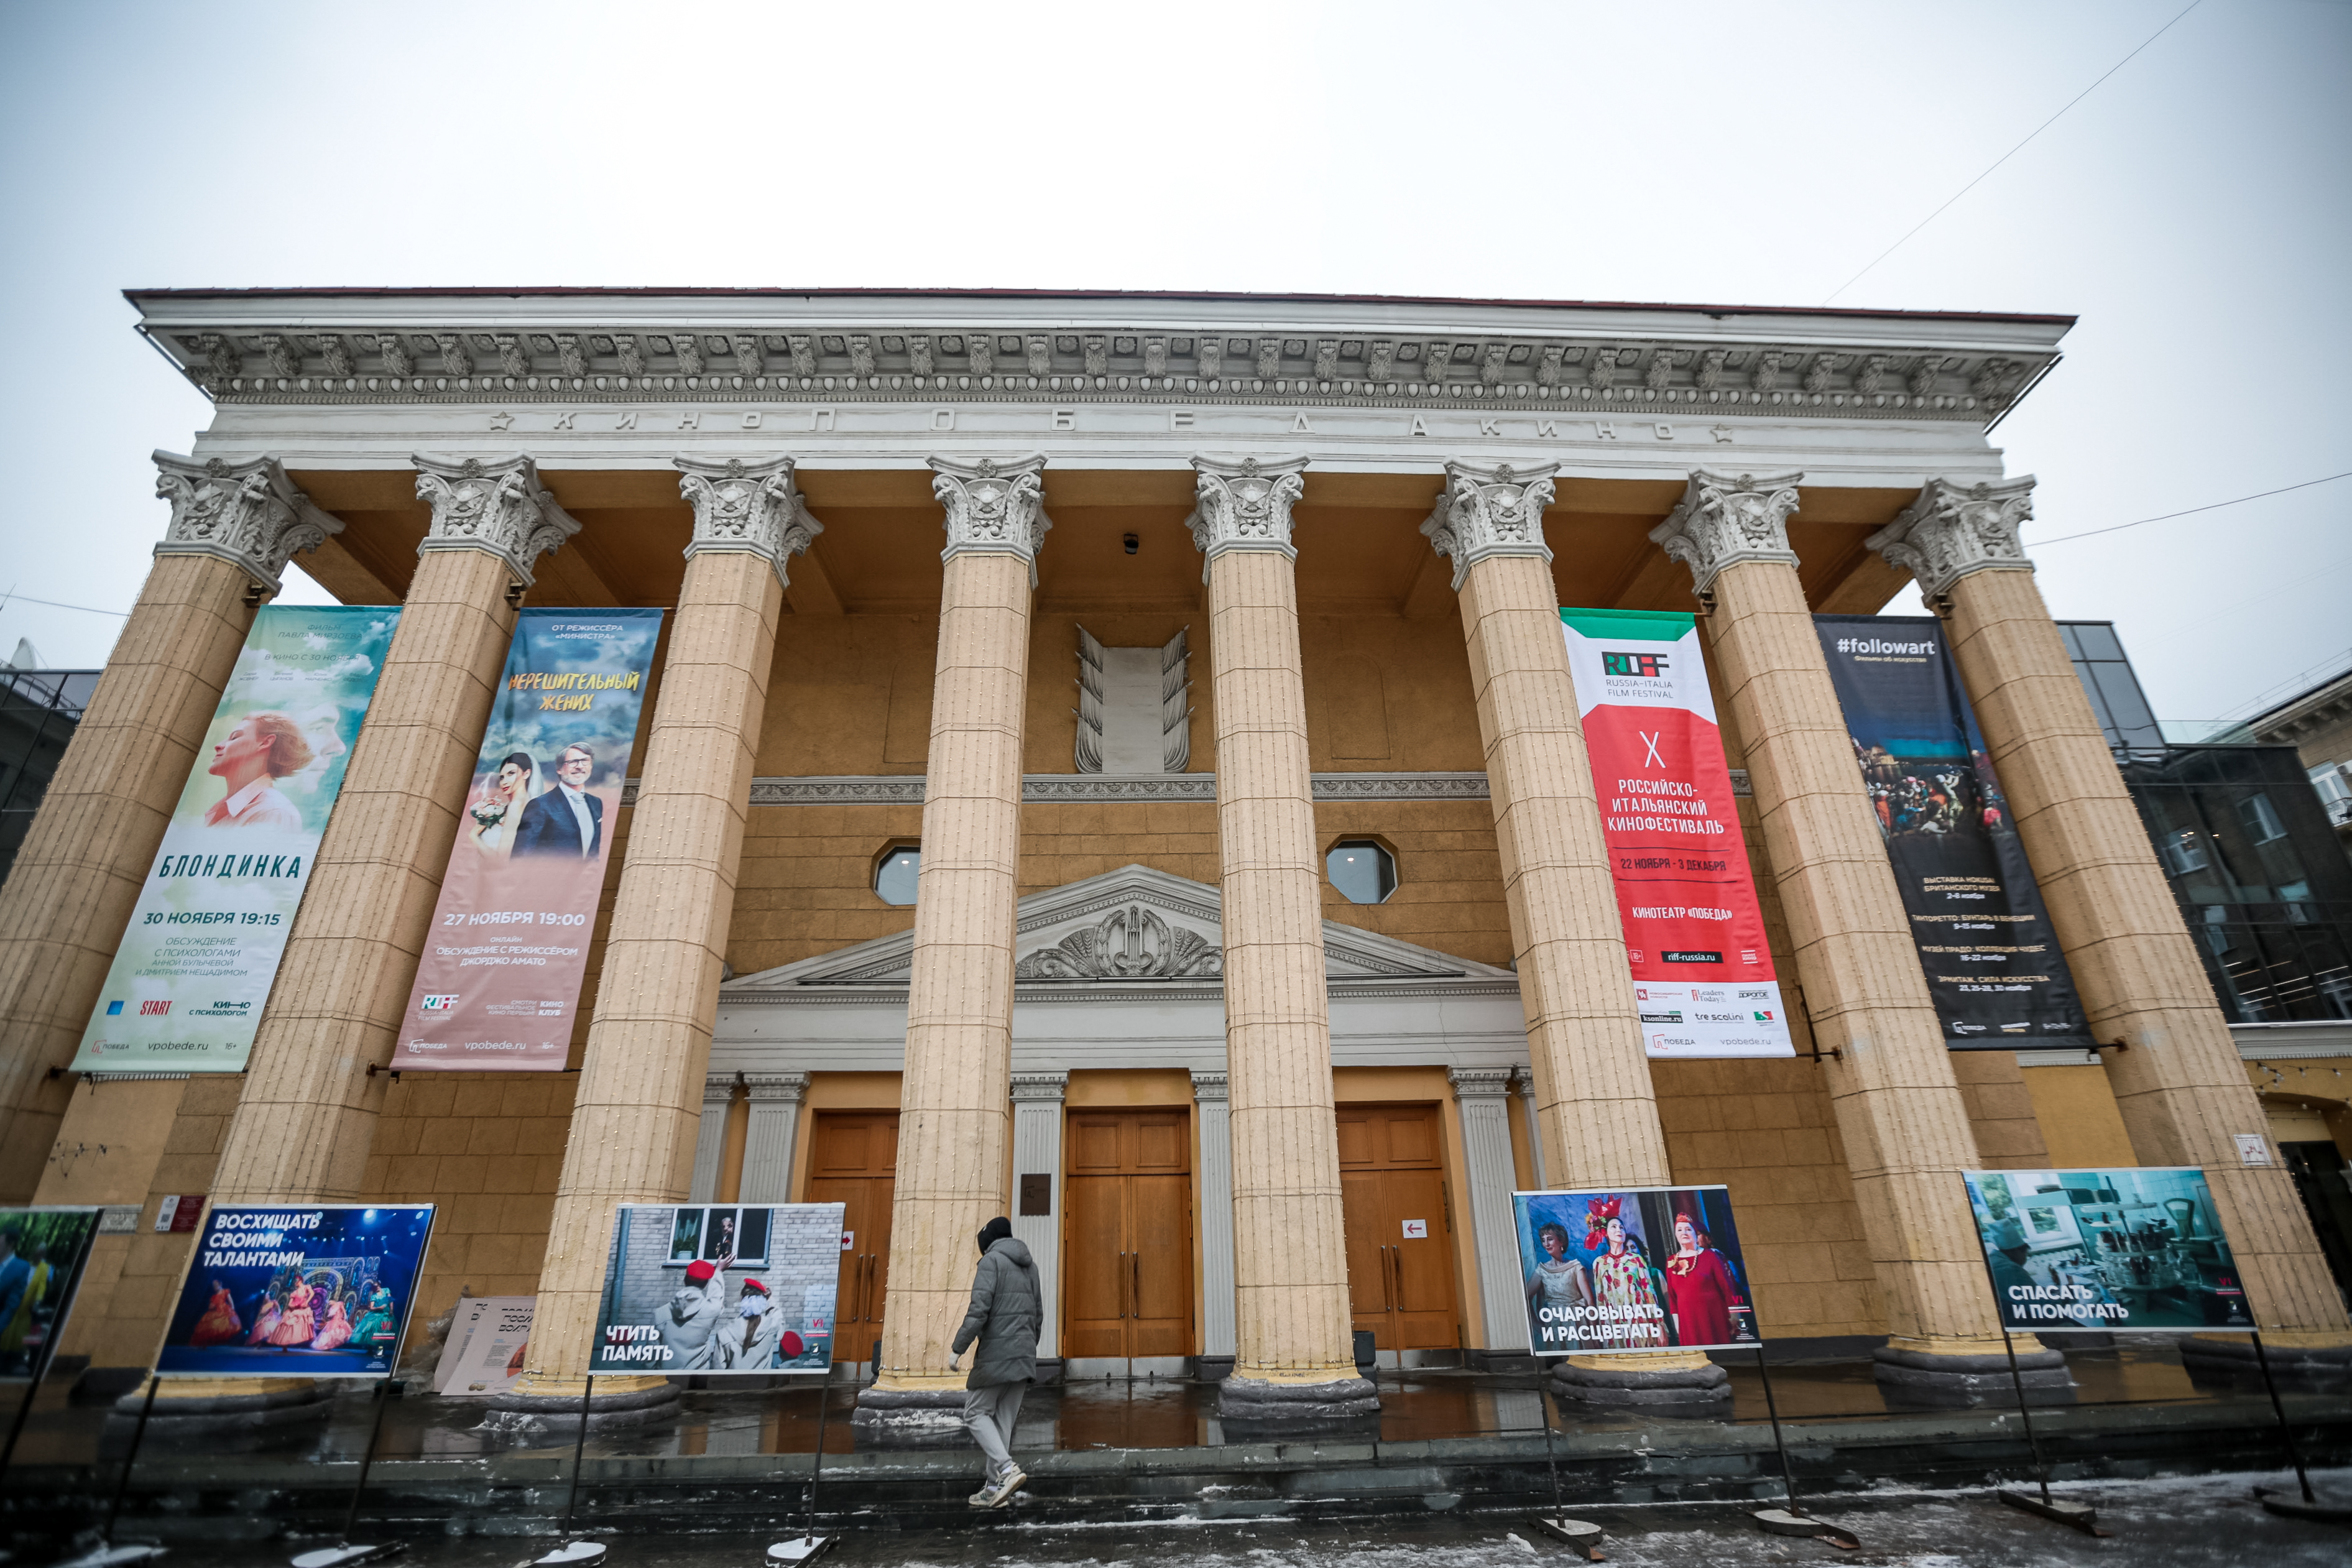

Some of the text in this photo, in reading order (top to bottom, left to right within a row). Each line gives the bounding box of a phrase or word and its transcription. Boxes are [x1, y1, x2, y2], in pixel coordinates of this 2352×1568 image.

[553, 408, 1674, 440] КИНО ПОБЕДА КИНО
[1837, 638, 1935, 655] #followart
[508, 671, 640, 691] НЕРЕШИТЕЛЬНЫЙ
[1633, 689, 1674, 698] FESTIVAL
[539, 694, 595, 711] ЖЕНИХ
[1618, 779, 1698, 797] РОССИЙСКО-
[1612, 798, 1708, 816] ИТАЛЬЯНСКИЙ
[1607, 816, 1724, 834] КИНОФЕСТИВАЛЬ
[159, 854, 301, 878] БЛОНДИНКА
[1621, 859, 1632, 869] 22
[1635, 859, 1671, 869] НОЯБРЯ
[1679, 859, 1684, 869] 3
[1687, 860, 1727, 871] ДЕКАБРЯ
[143, 912, 281, 925] 30 НОЯБРЯ 19:15
[443, 911, 586, 926] 27 НОЯБРЯ 19:00
[1632, 907, 1733, 921] КИНОТЕАТР «ПОБЕДА»
[165, 937, 238, 946] ОБСУЖДЕНИЕ
[154, 949, 241, 957] С ПСИХОЛОГАМИ
[436, 946, 499, 956] ОБСУЖДЕНИЕ
[508, 946, 578, 956] РЕЖИССЁРОМ
[1668, 952, 1715, 962] riff-russia.ru
[459, 957, 546, 967] ДЖОРДЖО АМАТО
[189, 969, 247, 977] НЕЩАДИМОМ
[140, 1000, 173, 1015] START
[1712, 1013, 1744, 1021] scolini
[148, 1041, 209, 1051] vpobede.ru
[465, 1041, 527, 1051] vpobede.ru
[542, 1041, 554, 1049] 16+
[215, 1214, 321, 1231] ВОСХИЩАТЬ
[210, 1233, 284, 1248] СВОИМИ
[203, 1252, 305, 1267] ТАЛАНТАМИ
[2219, 1278, 2232, 1286] VI
[1732, 1295, 1744, 1304] VI
[2008, 1284, 2093, 1300] СПАСАТЬ
[1539, 1304, 1664, 1323] ОЧАРОВЫВАТЬ
[2013, 1303, 2129, 1319] И ПОМОГАТЬ
[813, 1319, 824, 1327] VI
[606, 1324, 660, 1341] ЧТИТЬ
[1542, 1323, 1661, 1342] И РАСЦВЕТАТЬ
[601, 1345, 674, 1362] ПАМЯТЬ
